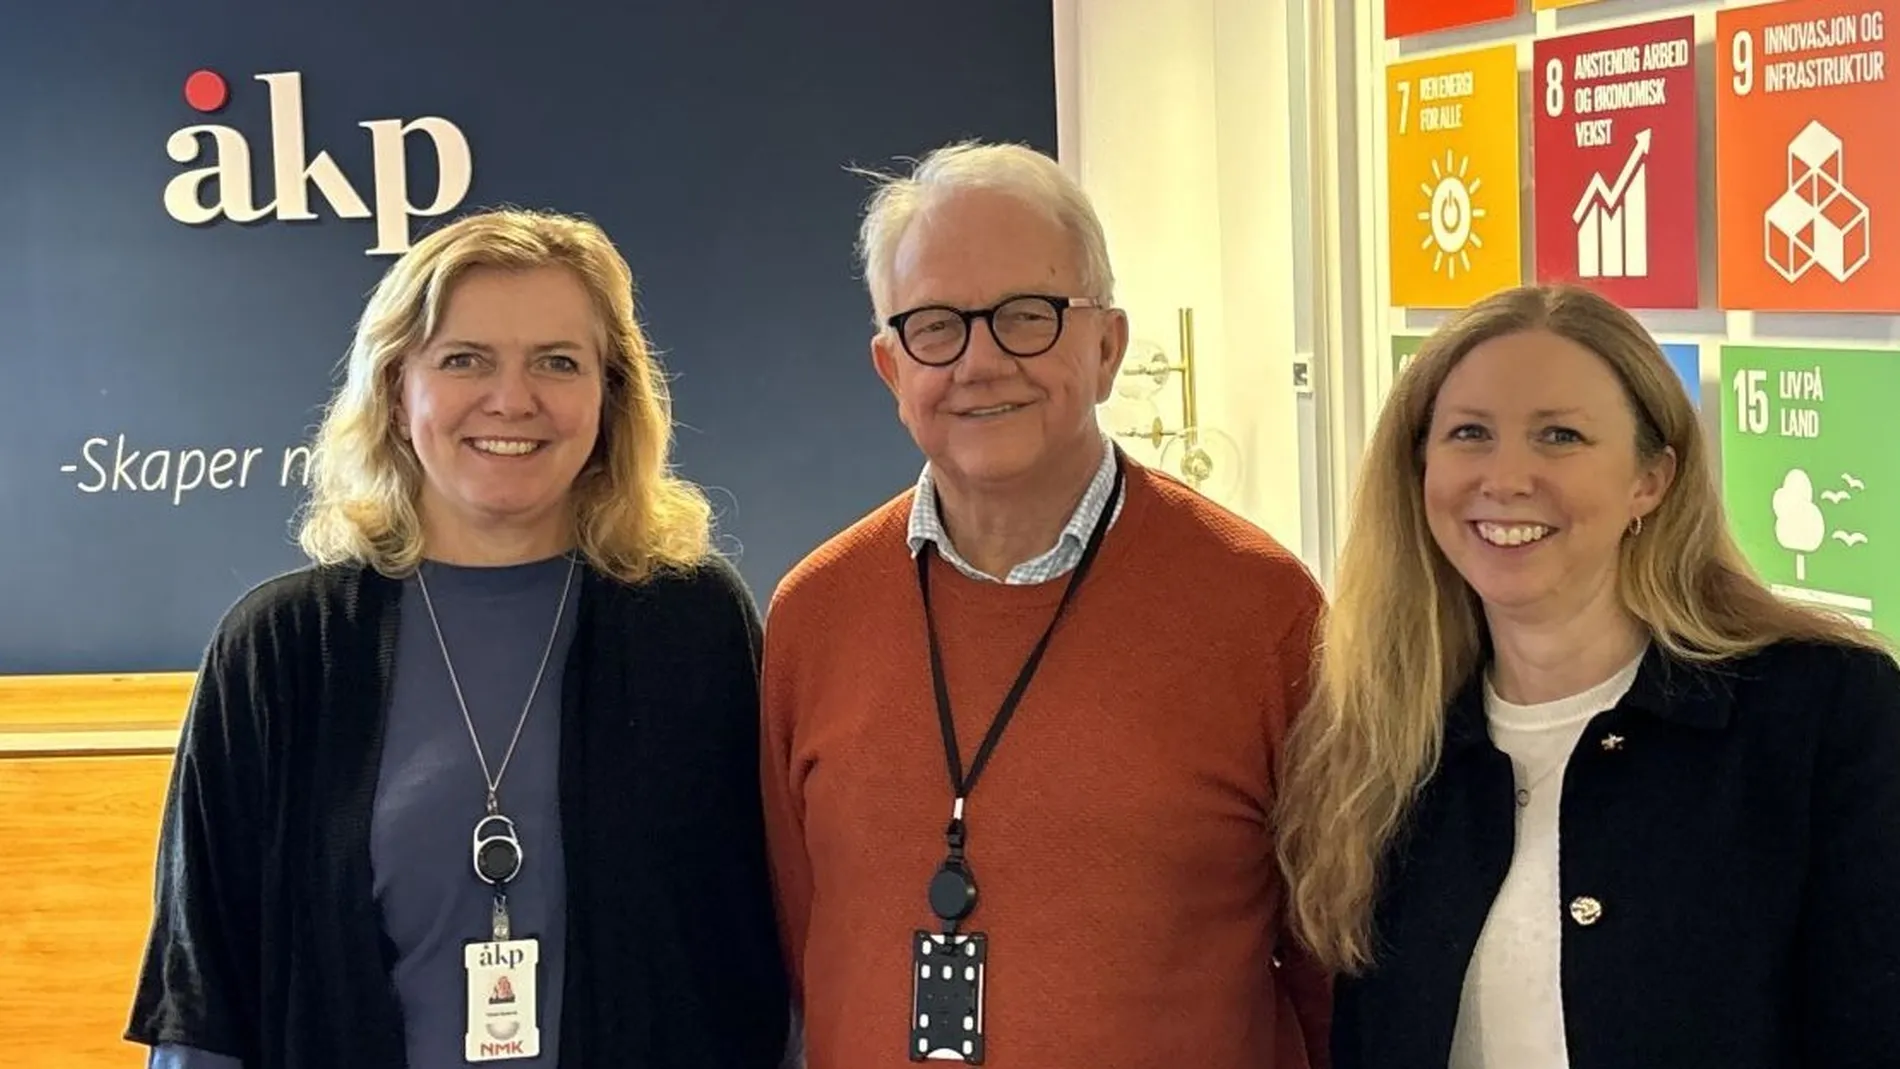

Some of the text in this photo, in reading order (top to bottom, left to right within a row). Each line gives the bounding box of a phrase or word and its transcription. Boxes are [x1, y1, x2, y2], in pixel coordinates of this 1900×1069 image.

[1764, 11, 1883, 55] INNOVASJON OG
[1574, 39, 1688, 80] ANSTENDIG ARBEID
[1732, 30, 1753, 96] 9
[1764, 51, 1884, 93] INFRASTRUKTUR
[1397, 80, 1410, 135] 7
[1546, 58, 1564, 117] 8
[1575, 78, 1666, 113] OG ØKONOMISK
[1440, 102, 1463, 129] ALLE
[1575, 118, 1613, 147] VEKST
[163, 68, 473, 256] åkp
[1733, 368, 1769, 434] 15
[1779, 365, 1824, 402] LIV PÅ
[1780, 407, 1819, 438] LAND
[60, 433, 263, 506] -Skaper
[479, 943, 524, 969] åkp
[480, 1040, 524, 1057] NMK
